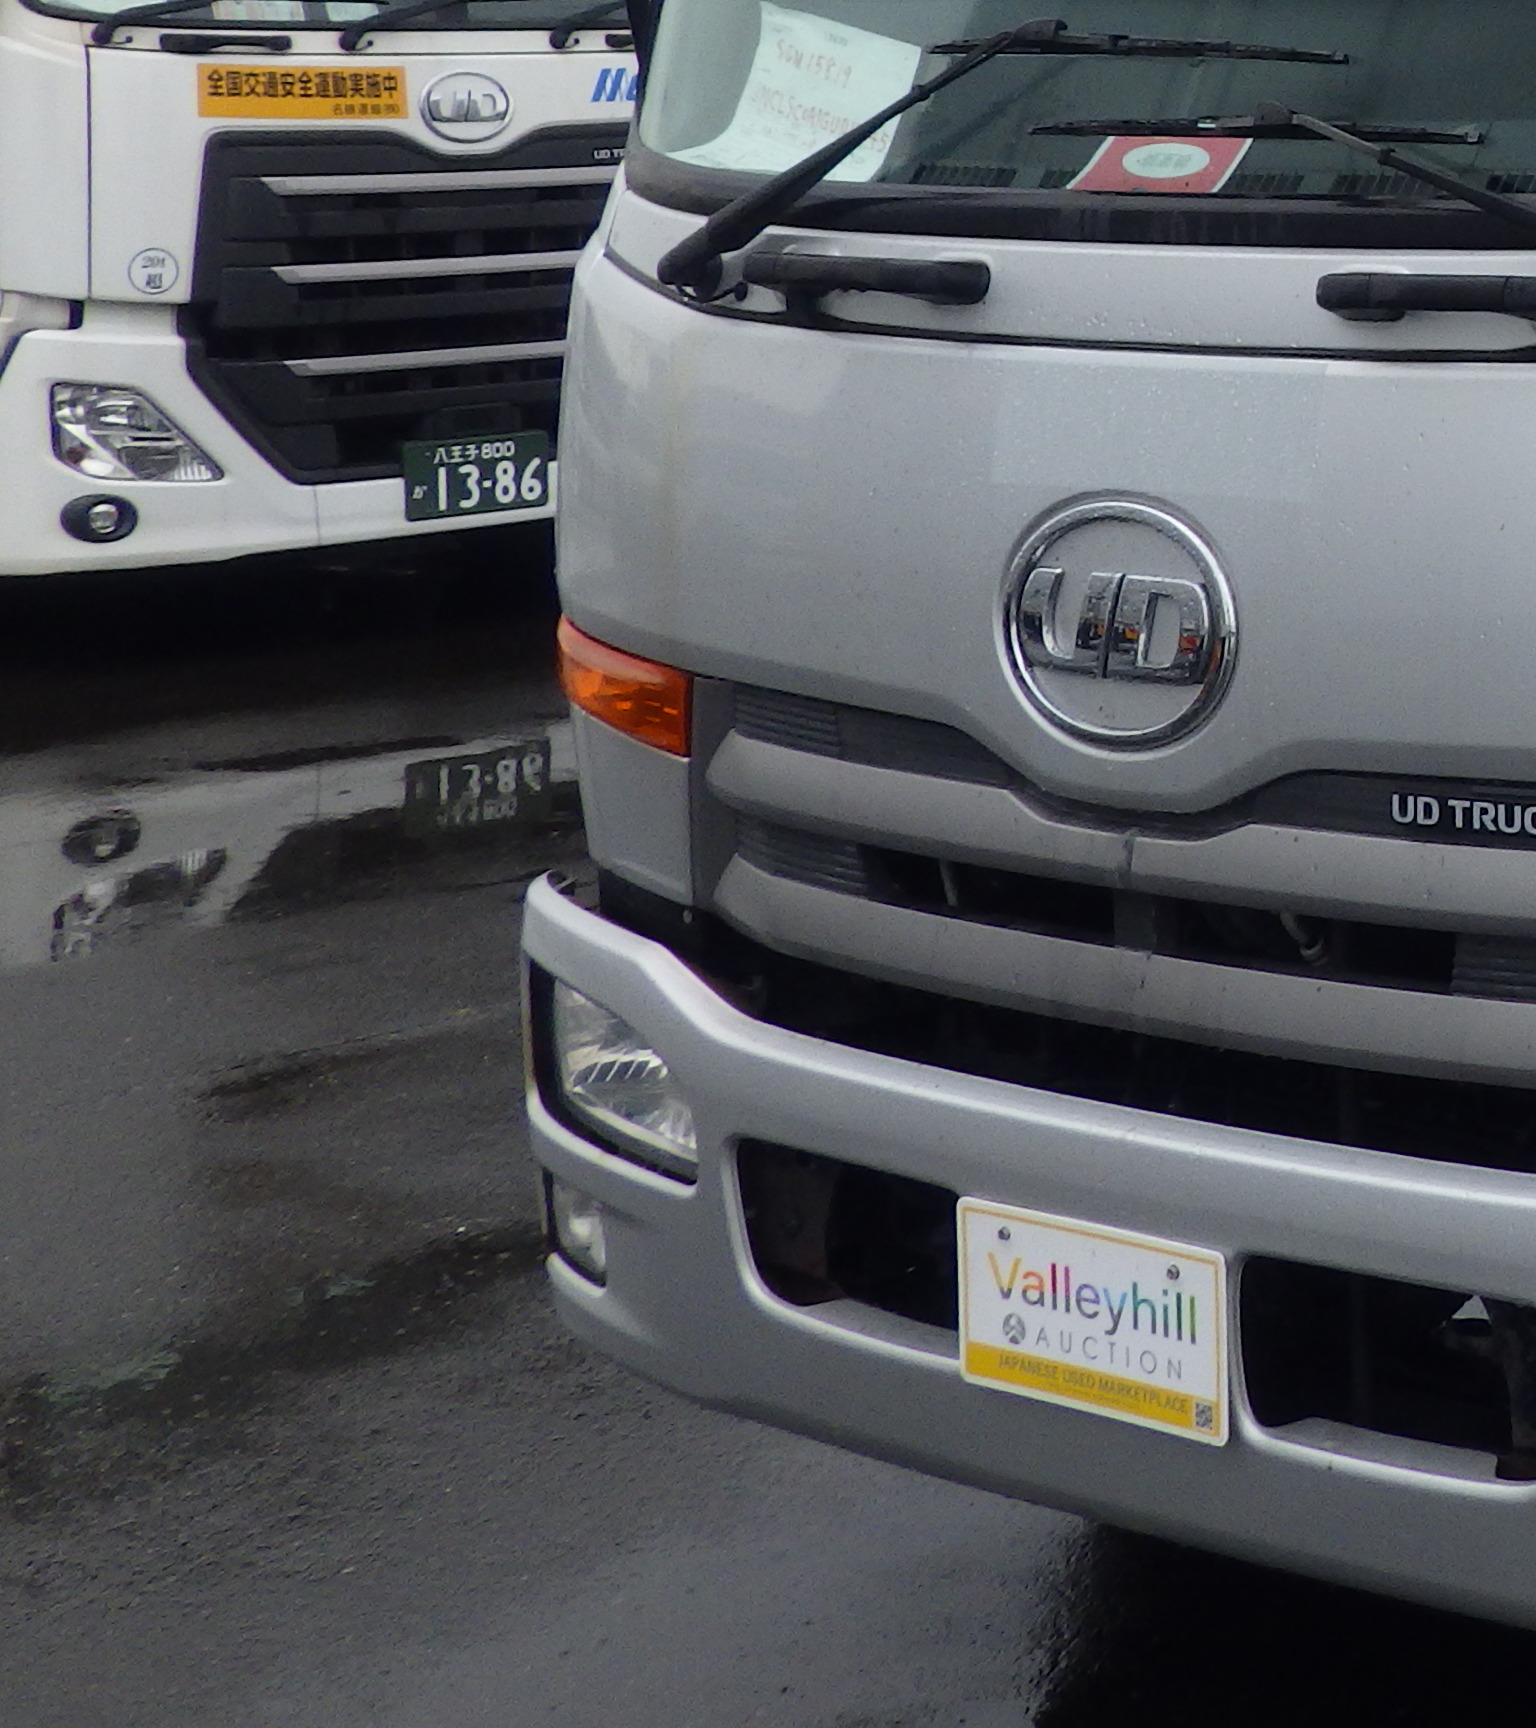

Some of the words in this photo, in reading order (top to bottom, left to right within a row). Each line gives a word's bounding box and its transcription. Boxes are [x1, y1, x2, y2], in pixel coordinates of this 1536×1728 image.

[207, 69, 398, 99] 全国交通安全運動実施中
[428, 90, 509, 122] UD
[593, 149, 611, 159] UD
[437, 456, 542, 512] 13-86
[1019, 566, 1214, 684] UD
[1391, 793, 1440, 826] UD
[987, 1251, 1197, 1345] Valleyhill
[1035, 1326, 1183, 1381] AUCTION
[998, 1354, 1059, 1380] JAPANESE
[1063, 1369, 1096, 1390] USED
[1099, 1378, 1189, 1414] MARKETPLACE
